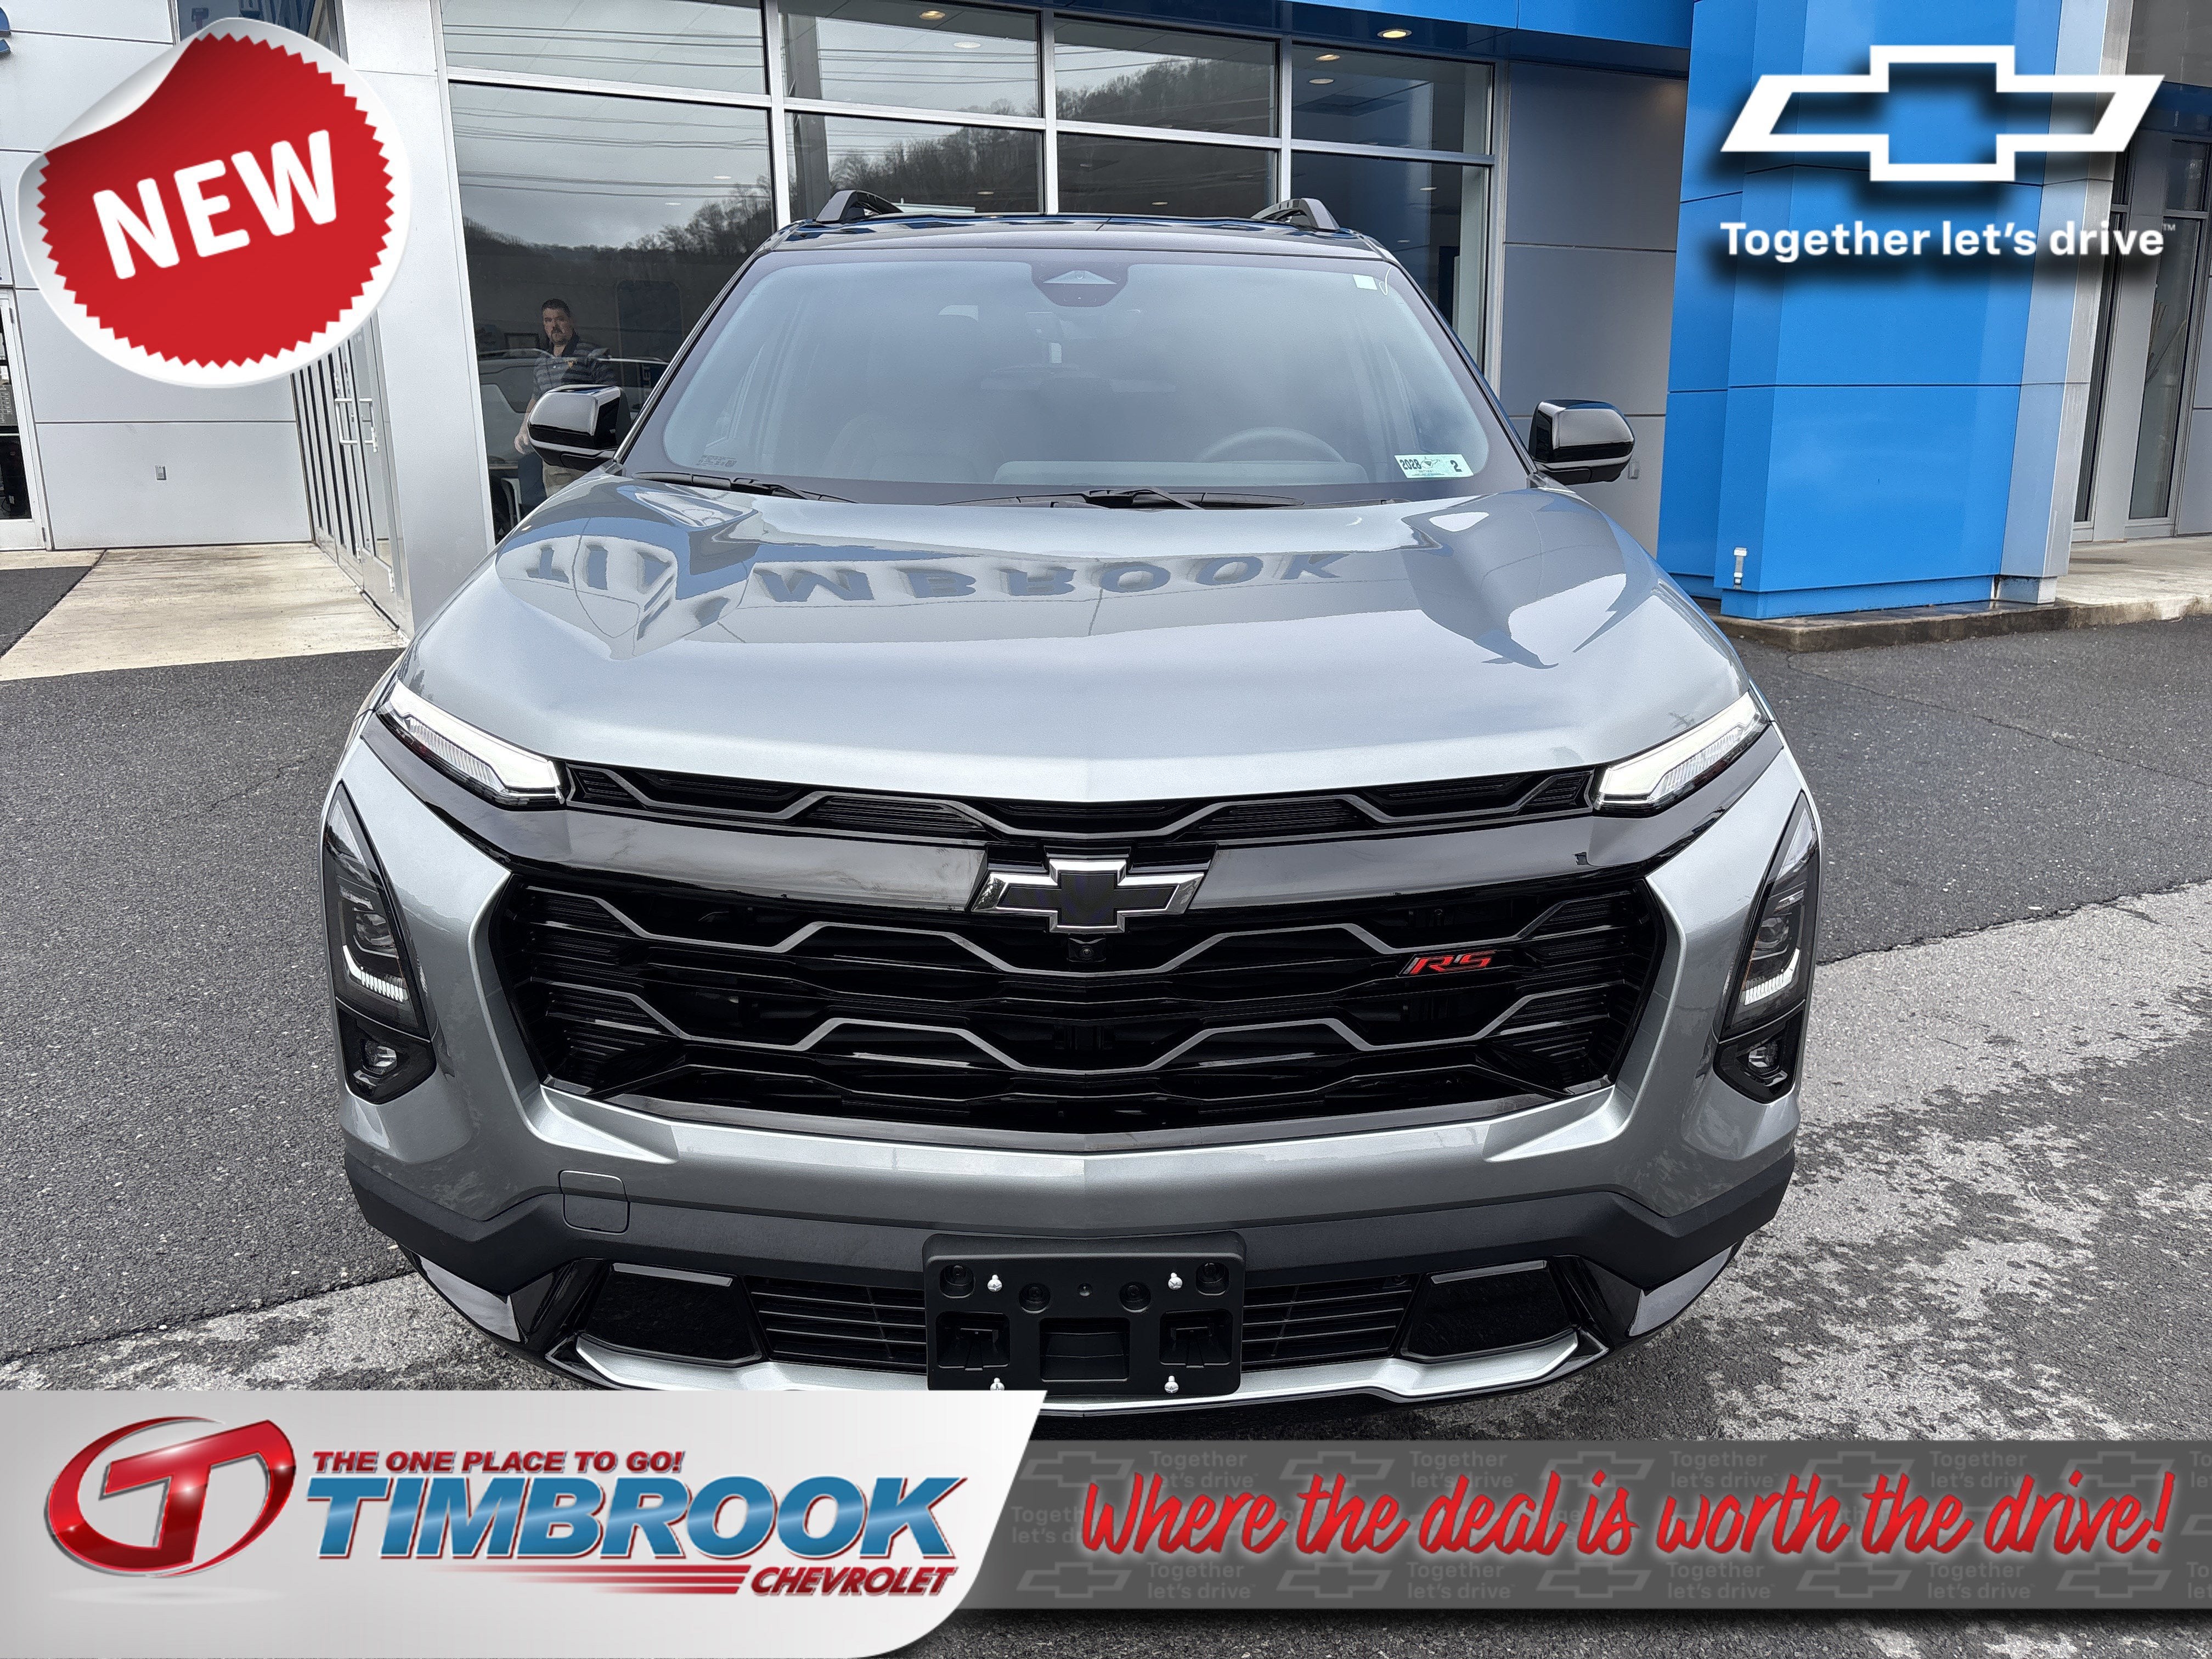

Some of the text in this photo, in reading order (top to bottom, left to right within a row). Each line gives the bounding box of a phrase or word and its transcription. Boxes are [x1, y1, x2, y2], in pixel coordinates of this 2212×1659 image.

[1400, 459, 1463, 472] 2028 2
[1402, 950, 1497, 974] RS
